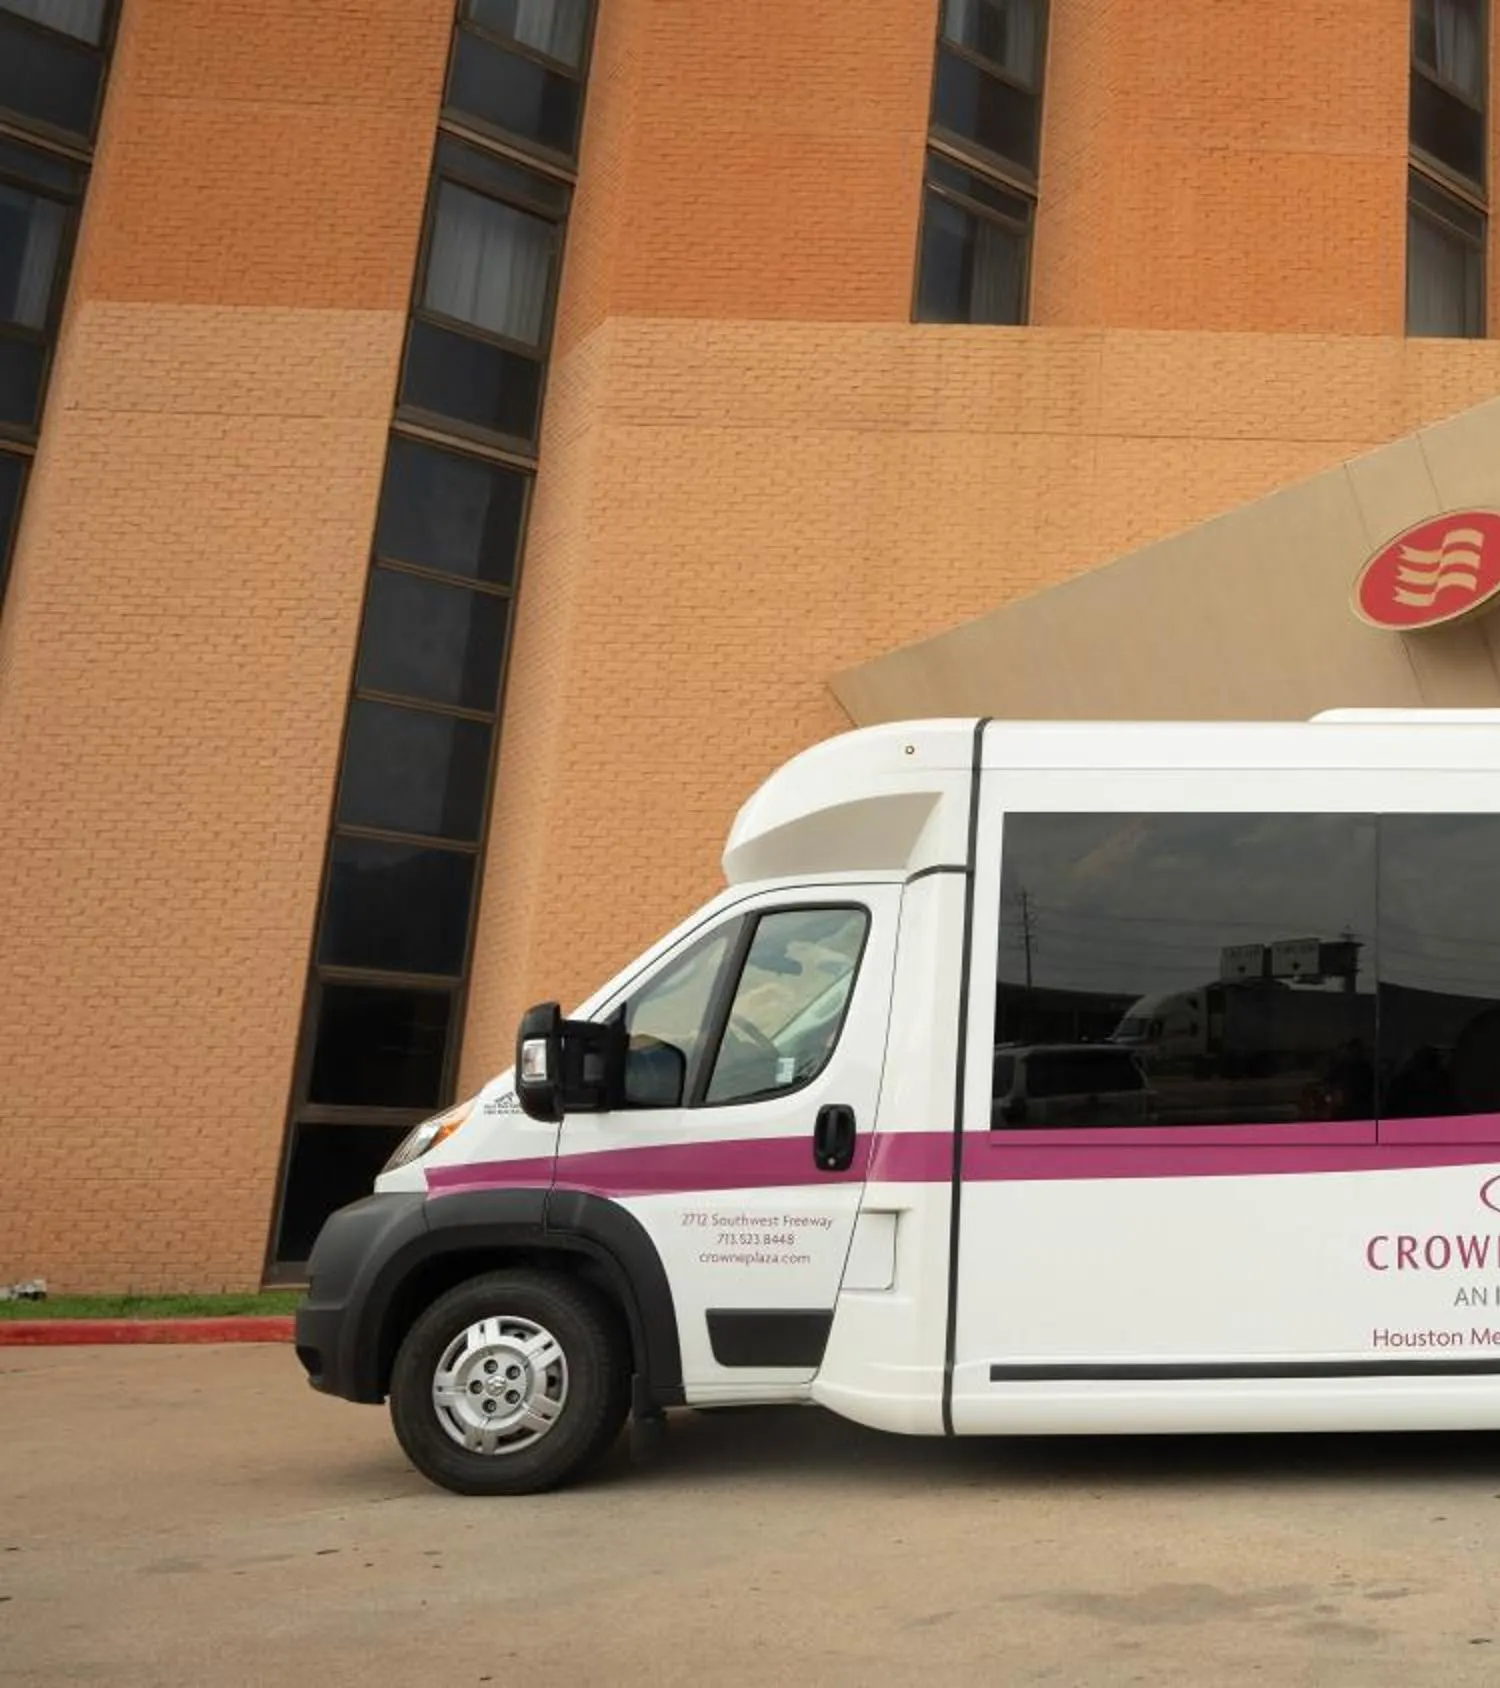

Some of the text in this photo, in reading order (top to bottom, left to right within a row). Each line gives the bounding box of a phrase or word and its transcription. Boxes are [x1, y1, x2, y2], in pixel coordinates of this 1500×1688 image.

[682, 1213, 834, 1230] 2712 Southwest Freeway
[699, 1250, 812, 1266] crowneplaza.com
[1453, 1286, 1488, 1307] AN
[1372, 1327, 1464, 1347] Houston
